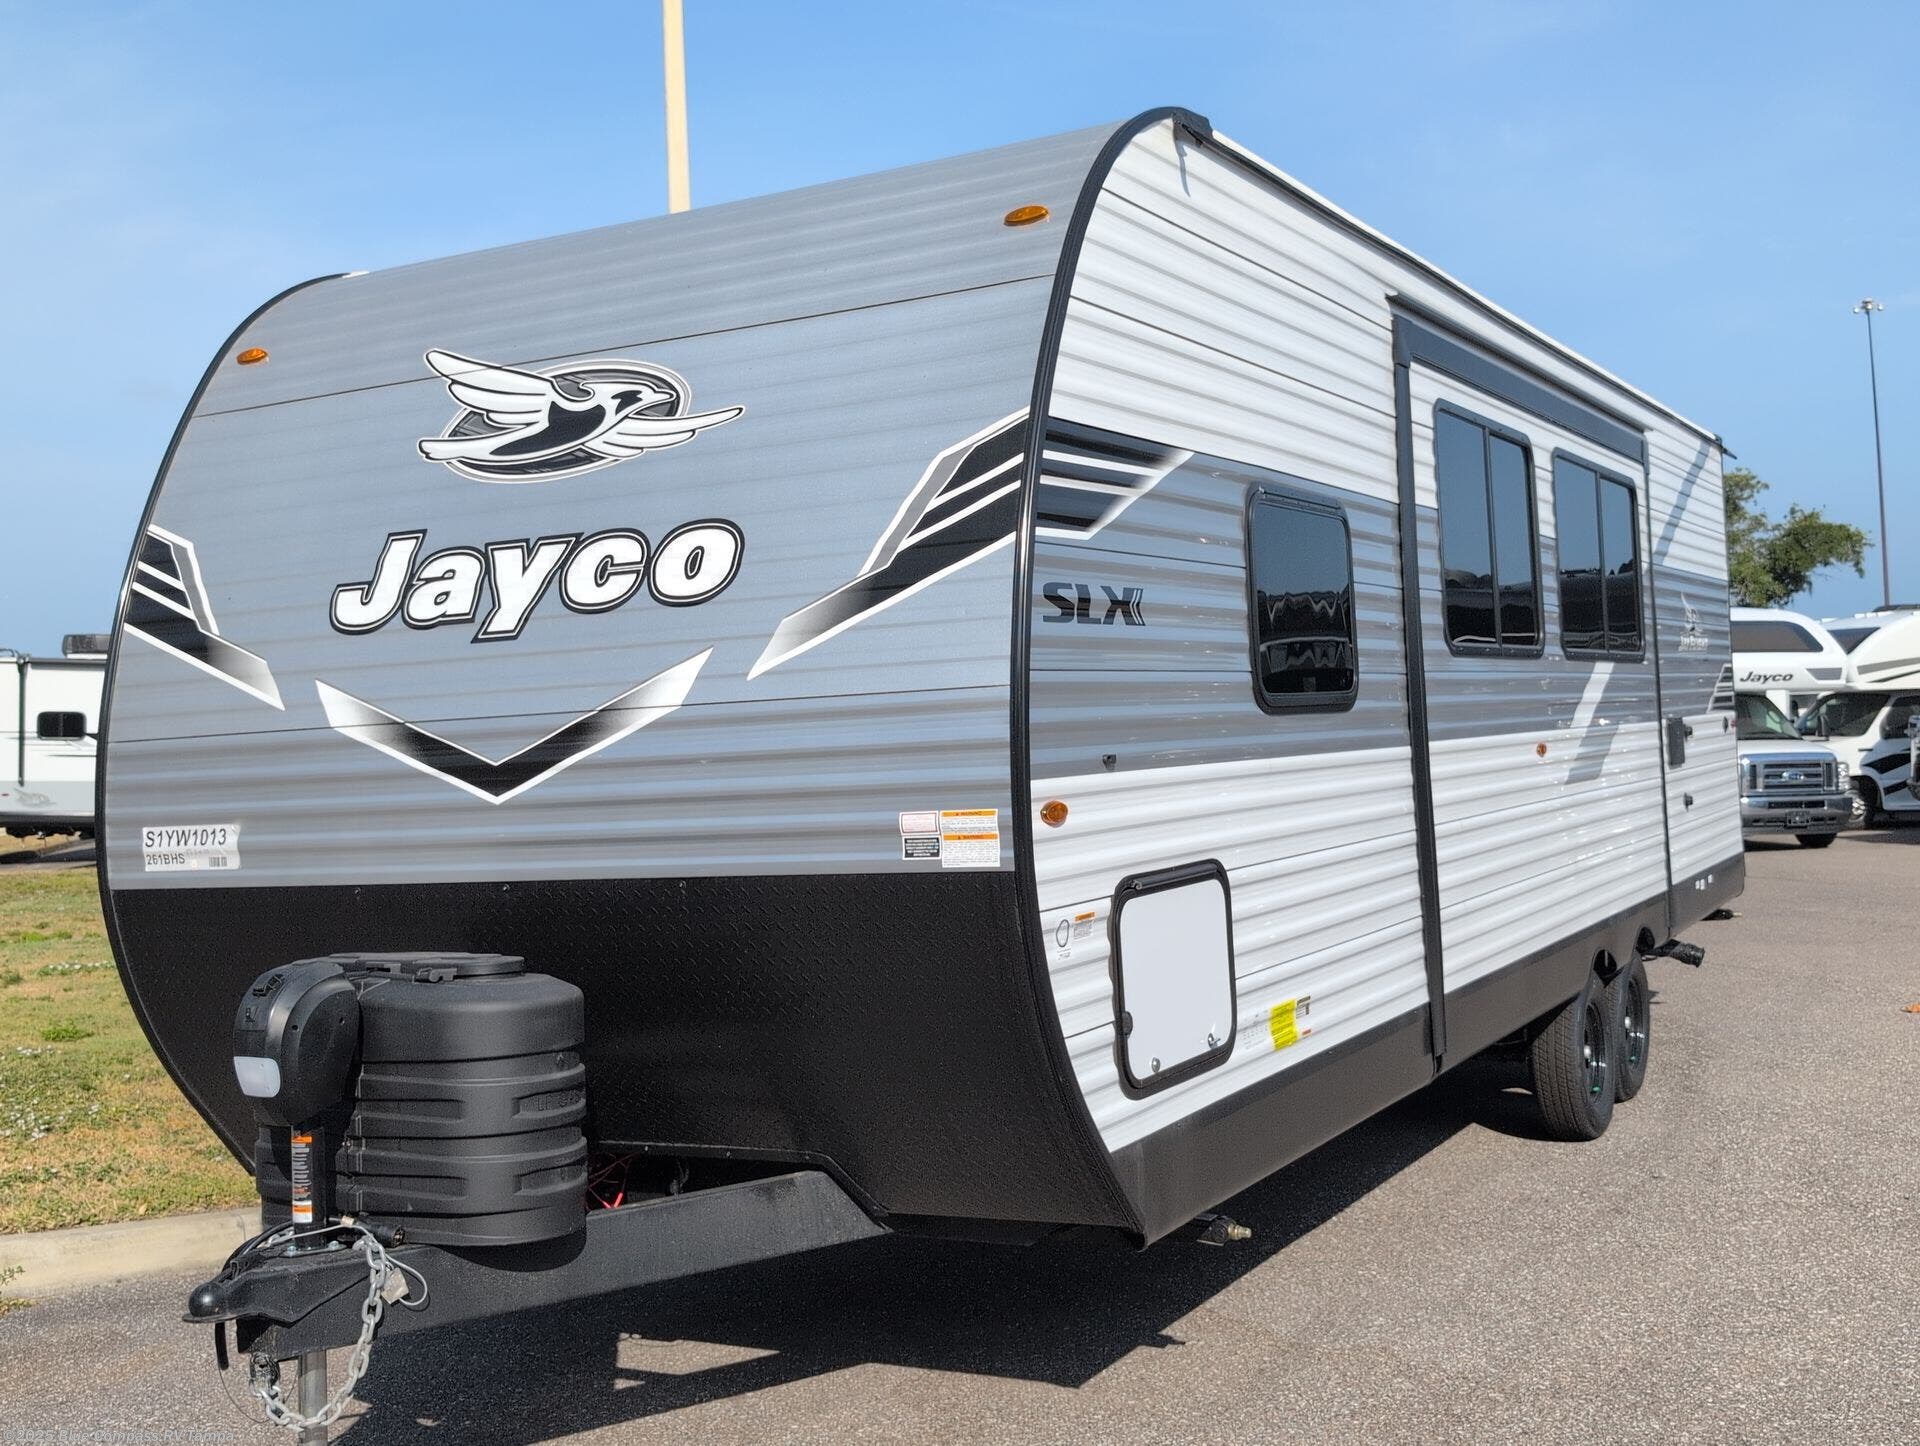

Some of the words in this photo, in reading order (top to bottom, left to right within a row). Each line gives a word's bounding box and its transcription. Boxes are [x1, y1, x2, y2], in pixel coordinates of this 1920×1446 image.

[330, 518, 745, 643] Jayco
[1043, 582, 1145, 626] SLX
[1740, 671, 1794, 685] Jayco
[145, 828, 227, 847] S1YW1013
[146, 853, 186, 865] 261BHS
